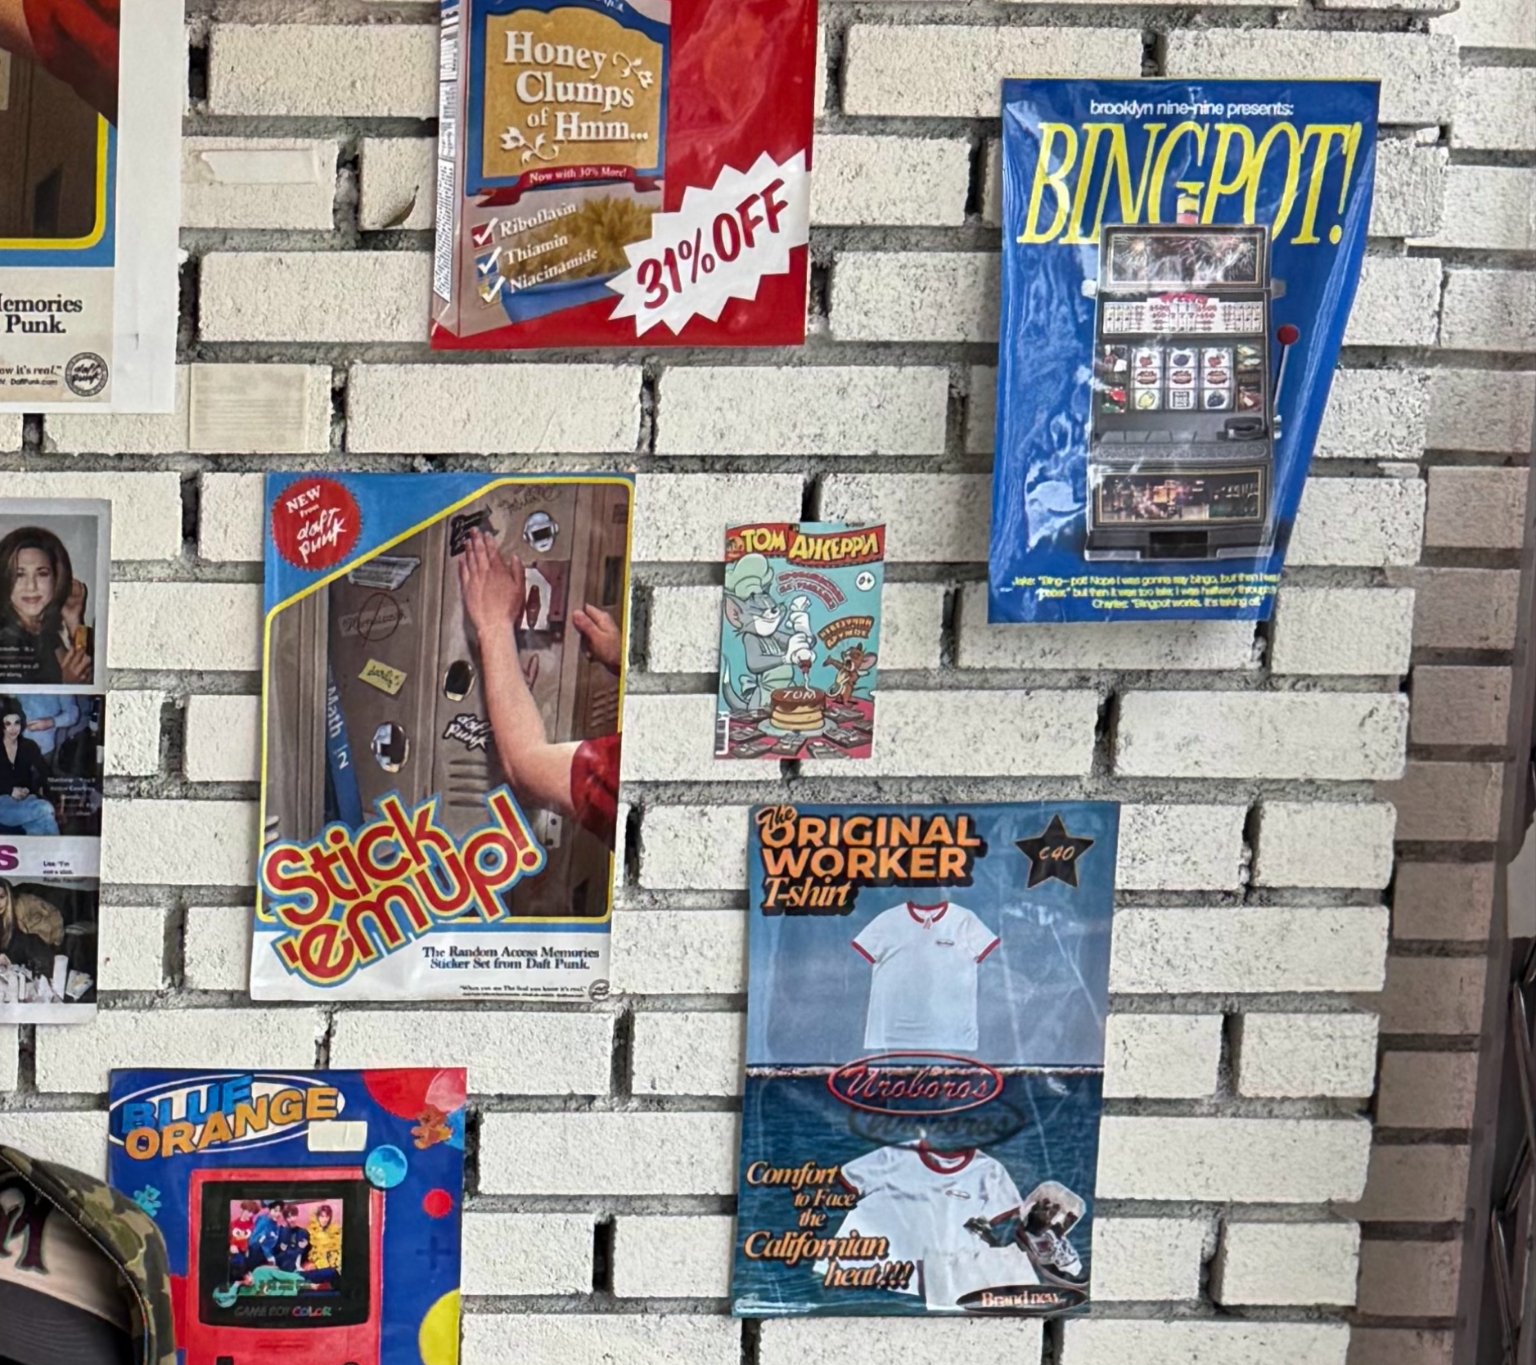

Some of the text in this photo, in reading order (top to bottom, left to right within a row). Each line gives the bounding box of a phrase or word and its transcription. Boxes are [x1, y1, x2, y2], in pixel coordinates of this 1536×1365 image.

[504, 30, 608, 80] Honey
[515, 70, 635, 113] Clumps
[527, 106, 649, 142] of Hmm...
[1090, 99, 1294, 119] brooklyn nine-nine presents:
[529, 167, 627, 184] Now with 30% More!
[1016, 121, 1363, 246] BINGPOT!
[499, 202, 578, 239] Riboflavin
[502, 234, 569, 267] Thiamin
[508, 248, 599, 294] Niacinamide
[5, 314, 68, 335] Punk.
[16, 364, 32, 375] it's
[285, 484, 321, 514] NEW
[296, 507, 342, 541] daft
[298, 517, 347, 564] punk
[327, 685, 344, 740] Math
[755, 804, 796, 832] The
[762, 815, 982, 849] ORIGINAL
[264, 794, 541, 927] Stick up!
[761, 847, 968, 879] WORKER
[763, 876, 853, 910] T-shirt
[280, 883, 427, 979] 'em
[422, 946, 600, 959] The Random Access Memories
[430, 957, 591, 971] Sticker Set from Daft Punk.
[845, 1063, 991, 1103] Uroboros
[121, 1074, 255, 1135] BLUE
[124, 1086, 342, 1162] ORANGE
[746, 1160, 840, 1191] Comfort
[794, 1187, 857, 1208] to Face
[797, 1208, 827, 1227] the
[744, 1231, 888, 1264] Californian
[824, 1260, 912, 1289] heat!!!
[291, 1305, 333, 1318] COLOR
[980, 1288, 1060, 1307] Brand new
